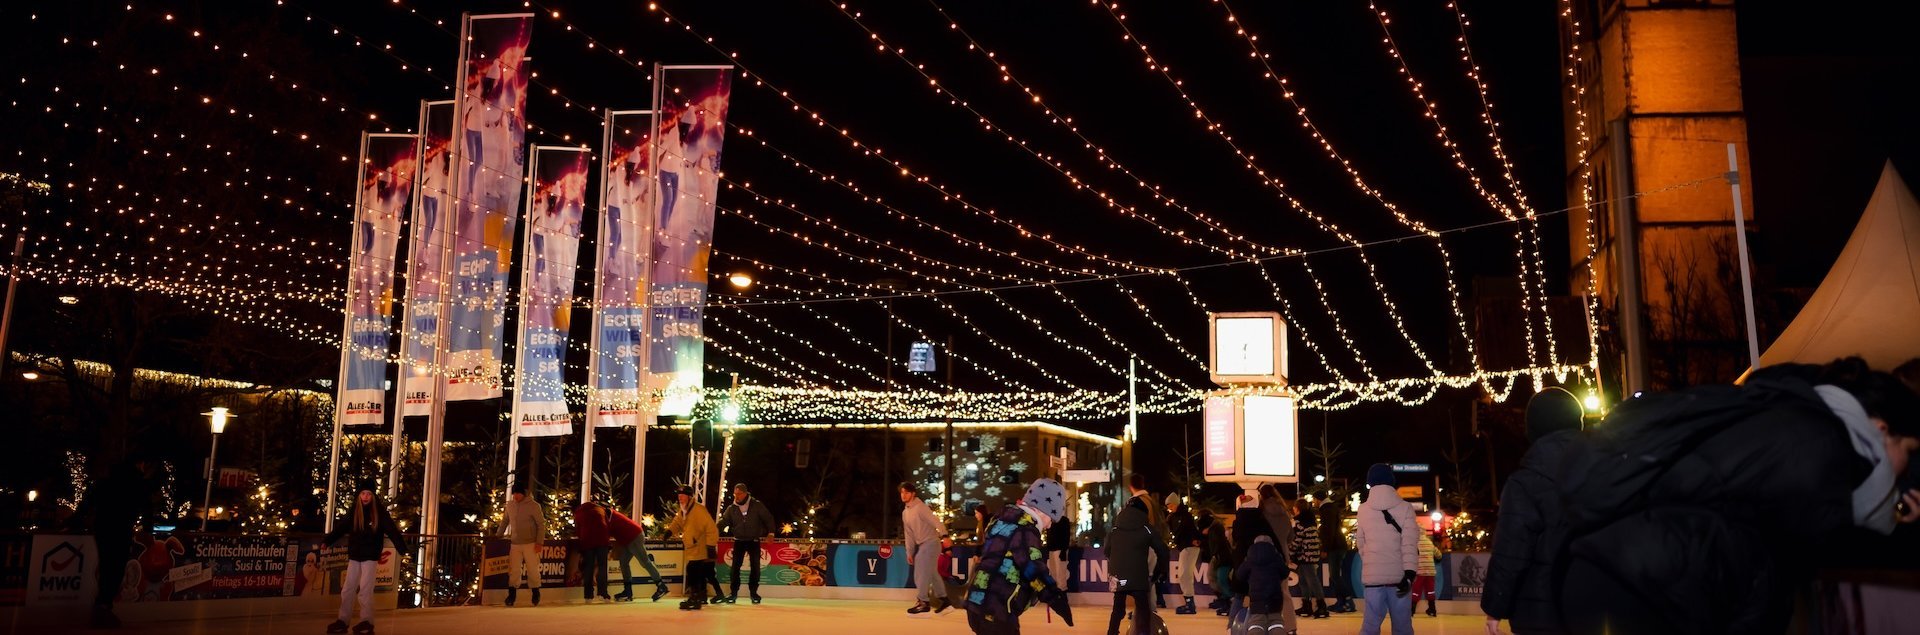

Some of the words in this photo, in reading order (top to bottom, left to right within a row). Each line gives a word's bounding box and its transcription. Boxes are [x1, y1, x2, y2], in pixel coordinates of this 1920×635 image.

[195, 543, 285, 558] Schlittschuhlaufen
[235, 559, 254, 571] Susi
[255, 560, 262, 571] &
[264, 559, 283, 571] Tino
[867, 558, 877, 573] V
[1079, 559, 1109, 583] IN
[40, 576, 81, 591] MWG
[212, 576, 241, 589] freitags
[244, 576, 266, 587] 16-18
[268, 575, 282, 586] Uhr
